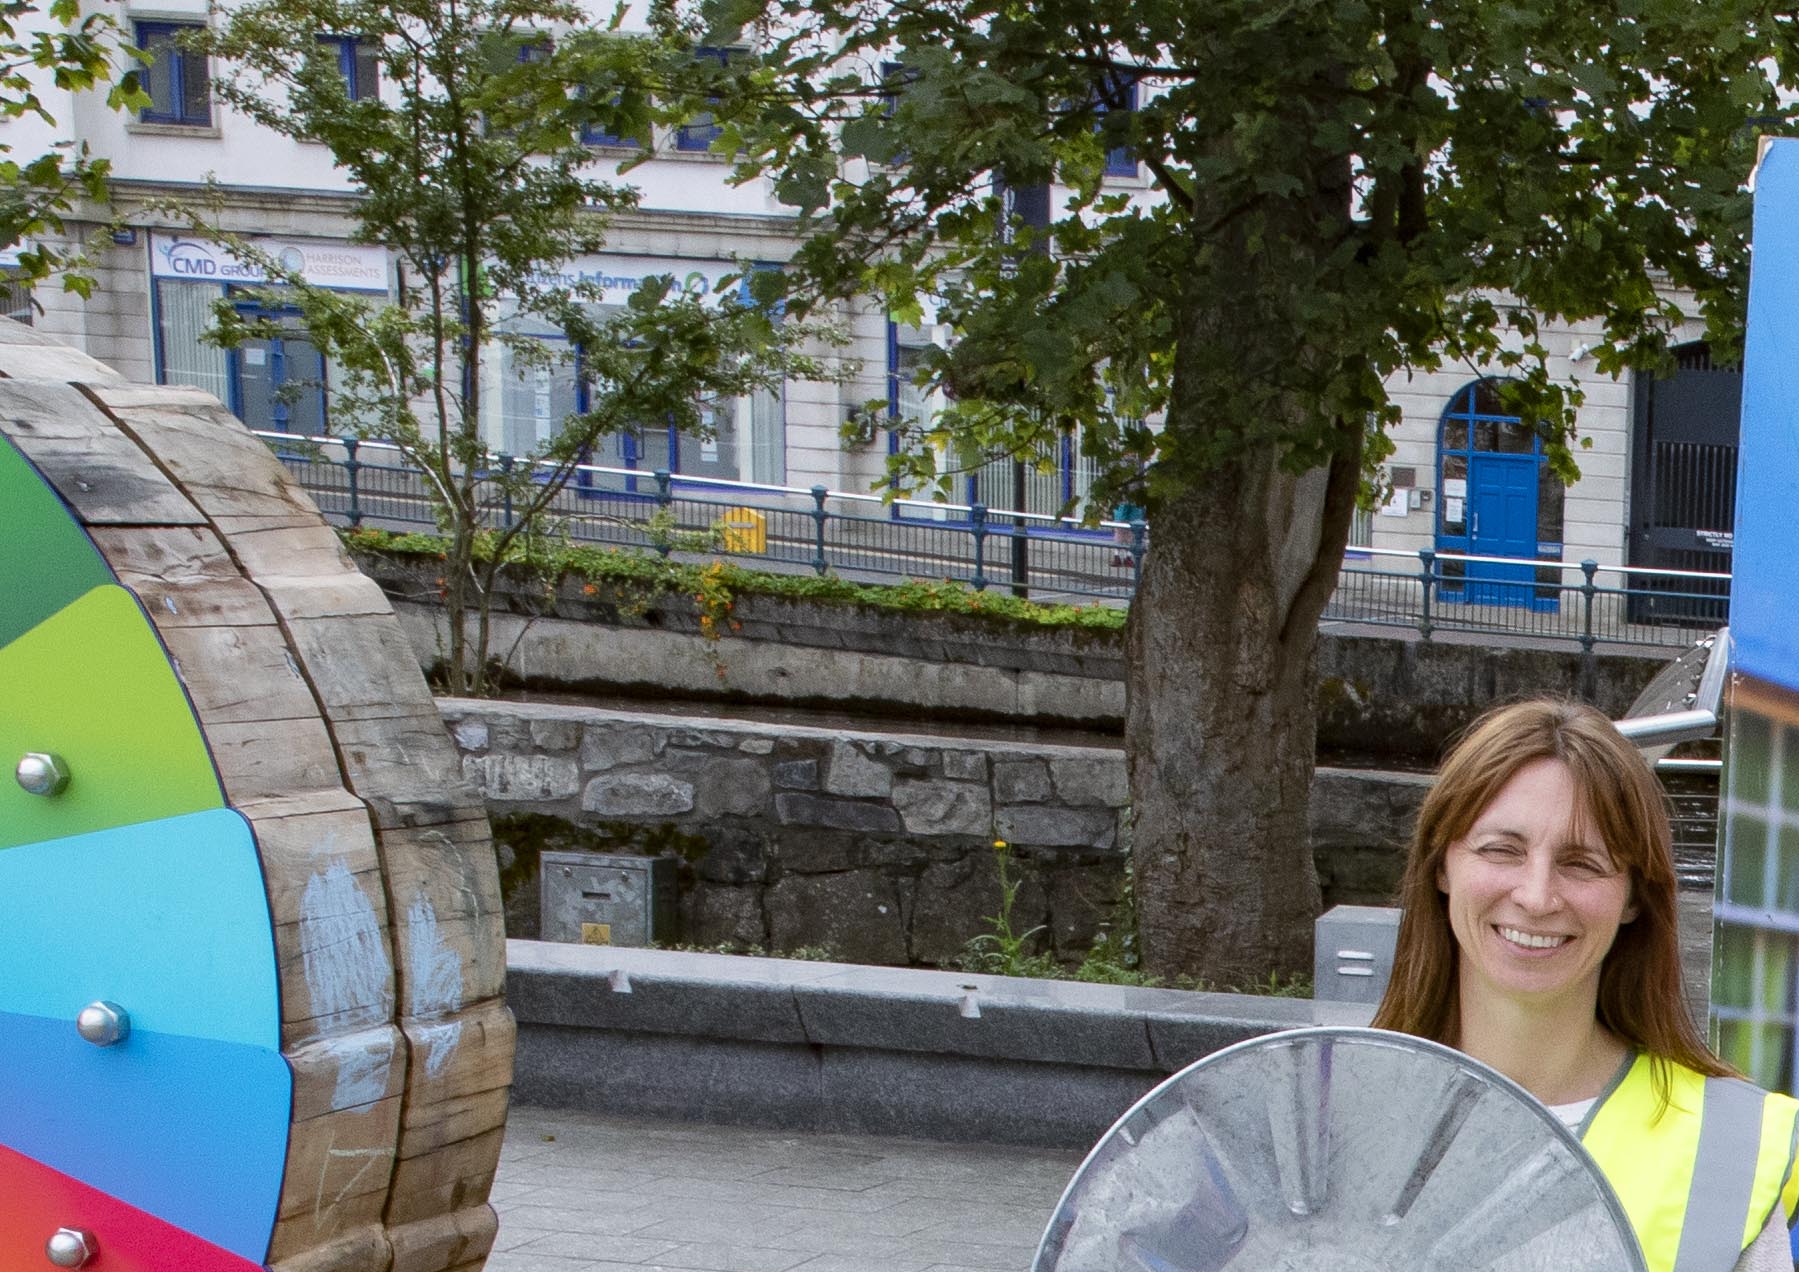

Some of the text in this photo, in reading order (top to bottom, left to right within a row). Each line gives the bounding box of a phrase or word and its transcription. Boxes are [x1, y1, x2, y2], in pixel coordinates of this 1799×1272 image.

[172, 257, 217, 275] CMD
[306, 252, 363, 266] HARRISON
[306, 263, 382, 279] ASSESSMENTS
